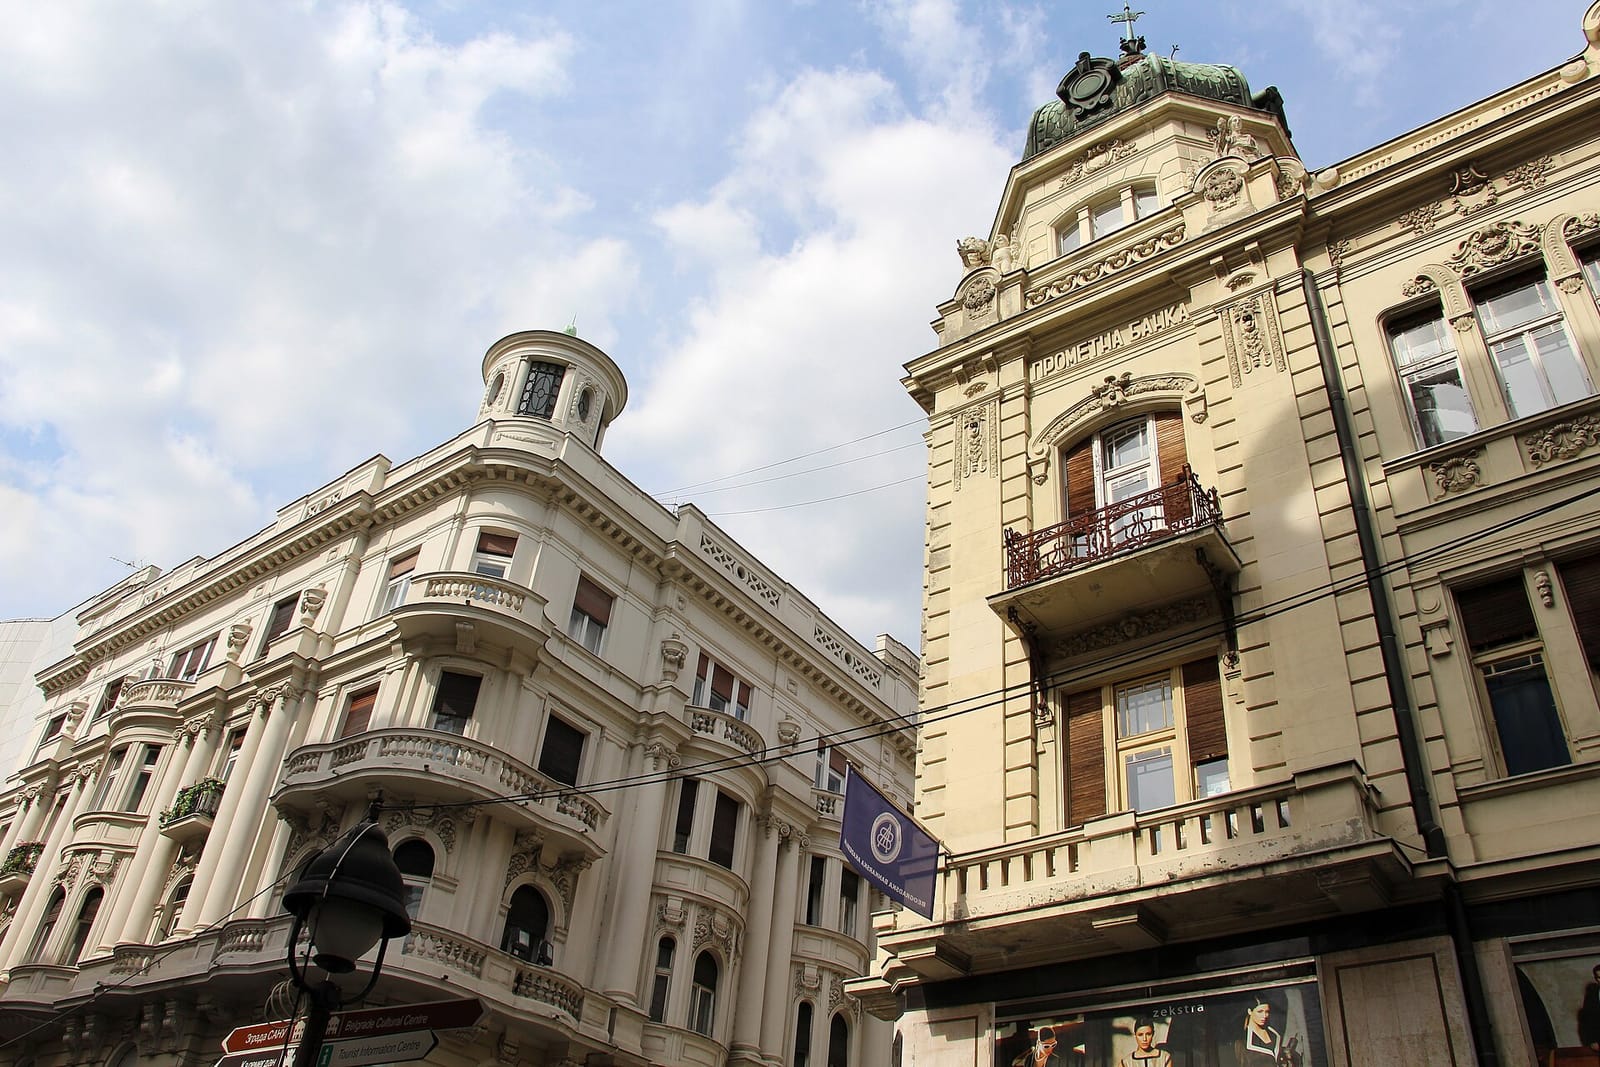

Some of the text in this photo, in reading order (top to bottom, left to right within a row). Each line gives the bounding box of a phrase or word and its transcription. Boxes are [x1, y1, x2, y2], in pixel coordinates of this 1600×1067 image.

[1031, 302, 1191, 381] ПРОМЕТНА БАНКА
[1152, 1004, 1204, 1018] zekstra
[345, 1014, 429, 1033] Belgrade Cultural Centre
[267, 1027, 289, 1041] САНУ
[340, 1040, 420, 1059] Tourist Information Centre
